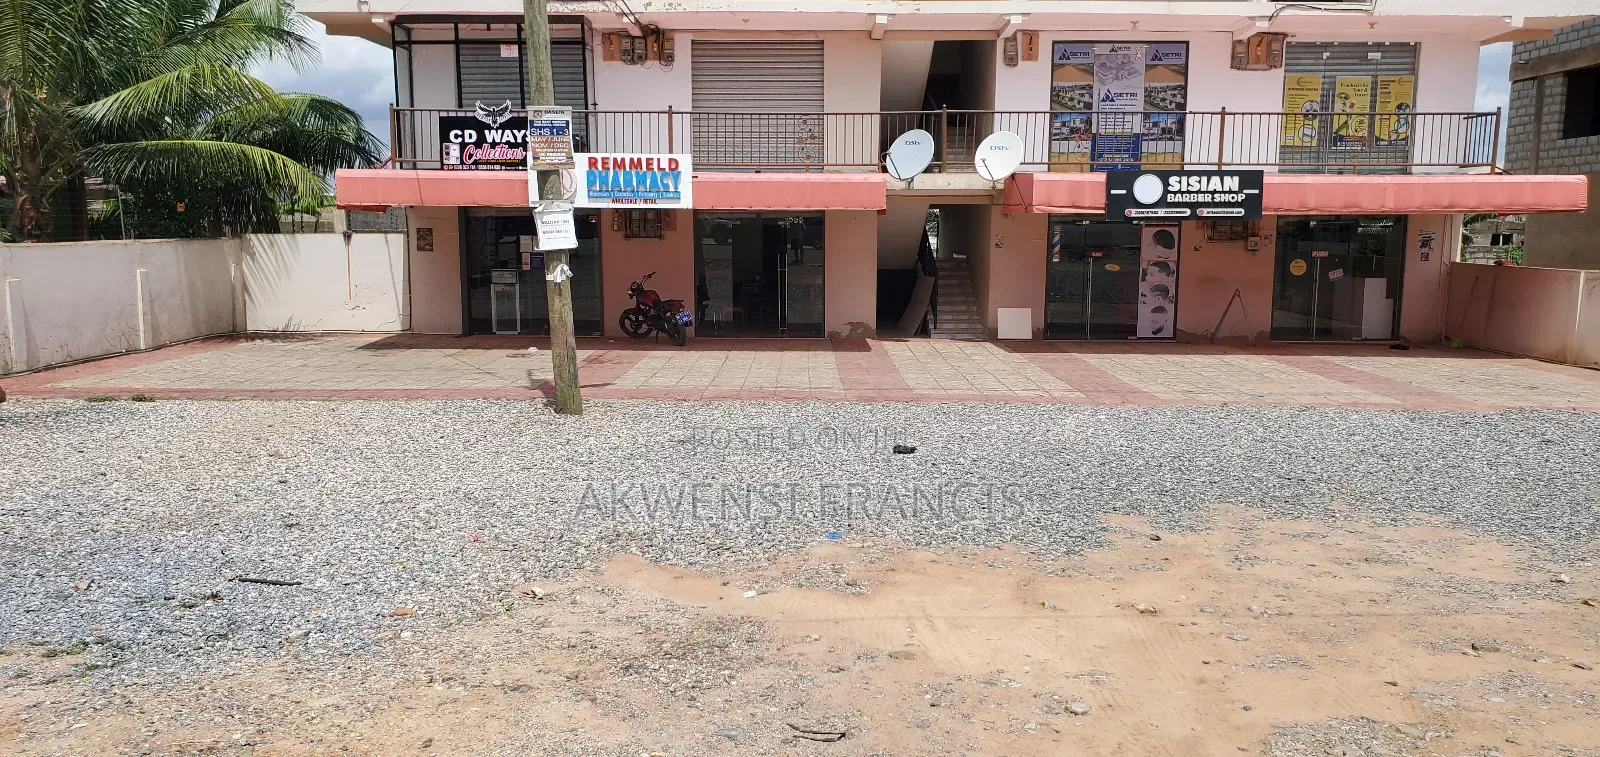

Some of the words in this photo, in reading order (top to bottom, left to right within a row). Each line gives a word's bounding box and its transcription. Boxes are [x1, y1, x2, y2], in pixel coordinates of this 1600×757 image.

[449, 129, 477, 143] CD
[530, 128, 550, 136] SHS
[552, 128, 557, 136] 1
[563, 128, 569, 136] 3
[463, 144, 526, 164] Collections
[588, 156, 680, 171] REMMELD
[586, 169, 682, 191] PHARMACY
[1167, 175, 1240, 192] SISIAN
[1167, 193, 1213, 202] BARBER
[1213, 193, 1246, 202] SHOP
